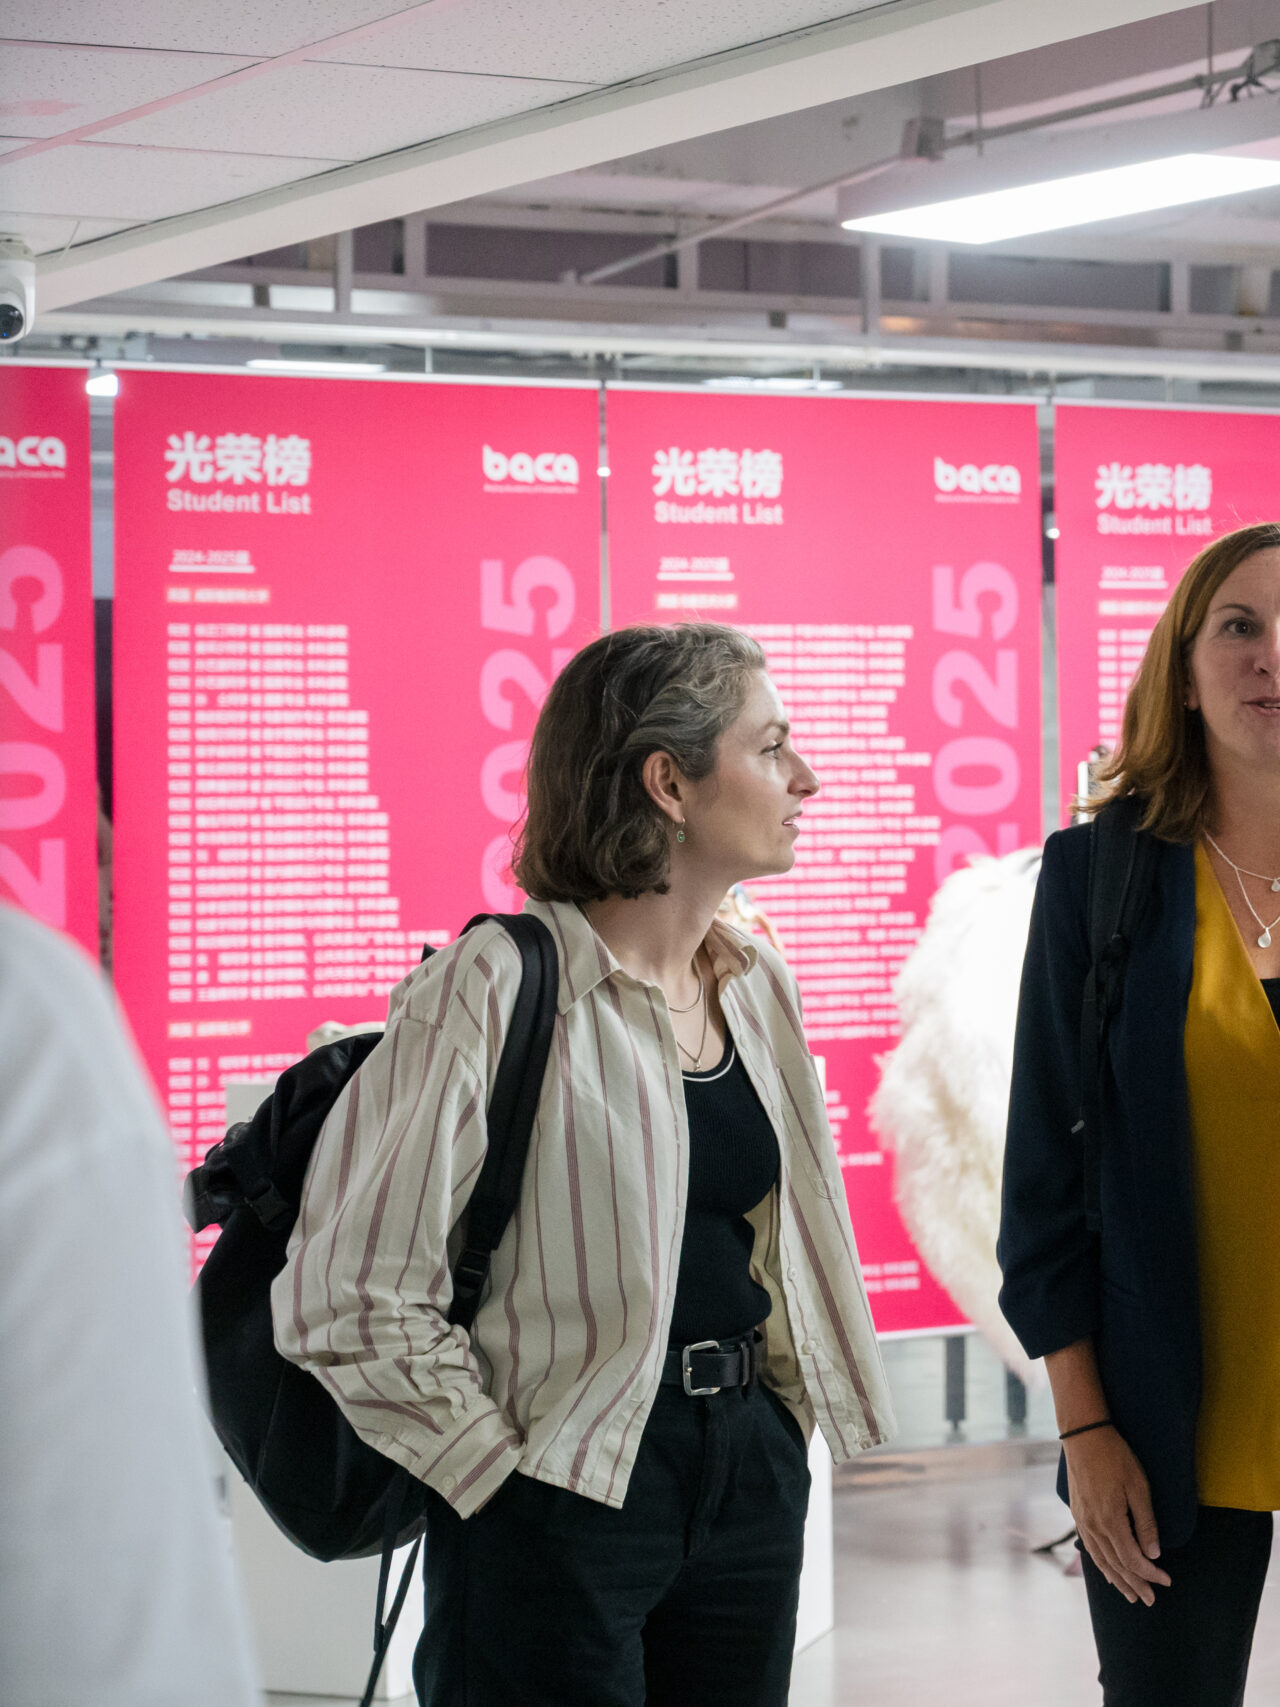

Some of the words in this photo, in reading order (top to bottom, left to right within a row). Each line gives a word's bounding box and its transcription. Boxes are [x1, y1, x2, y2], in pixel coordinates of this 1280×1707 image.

[164, 431, 311, 486] 光荣榜
[482, 443, 579, 484] baca
[652, 447, 783, 498] 光荣榜
[934, 456, 1021, 494] baca
[167, 488, 260, 513] Student
[266, 491, 311, 514] List
[1095, 462, 1212, 511] 光荣榜
[654, 501, 738, 524] Student
[742, 502, 783, 525] List
[1097, 513, 1172, 535] Student
[1175, 515, 1213, 535] List
